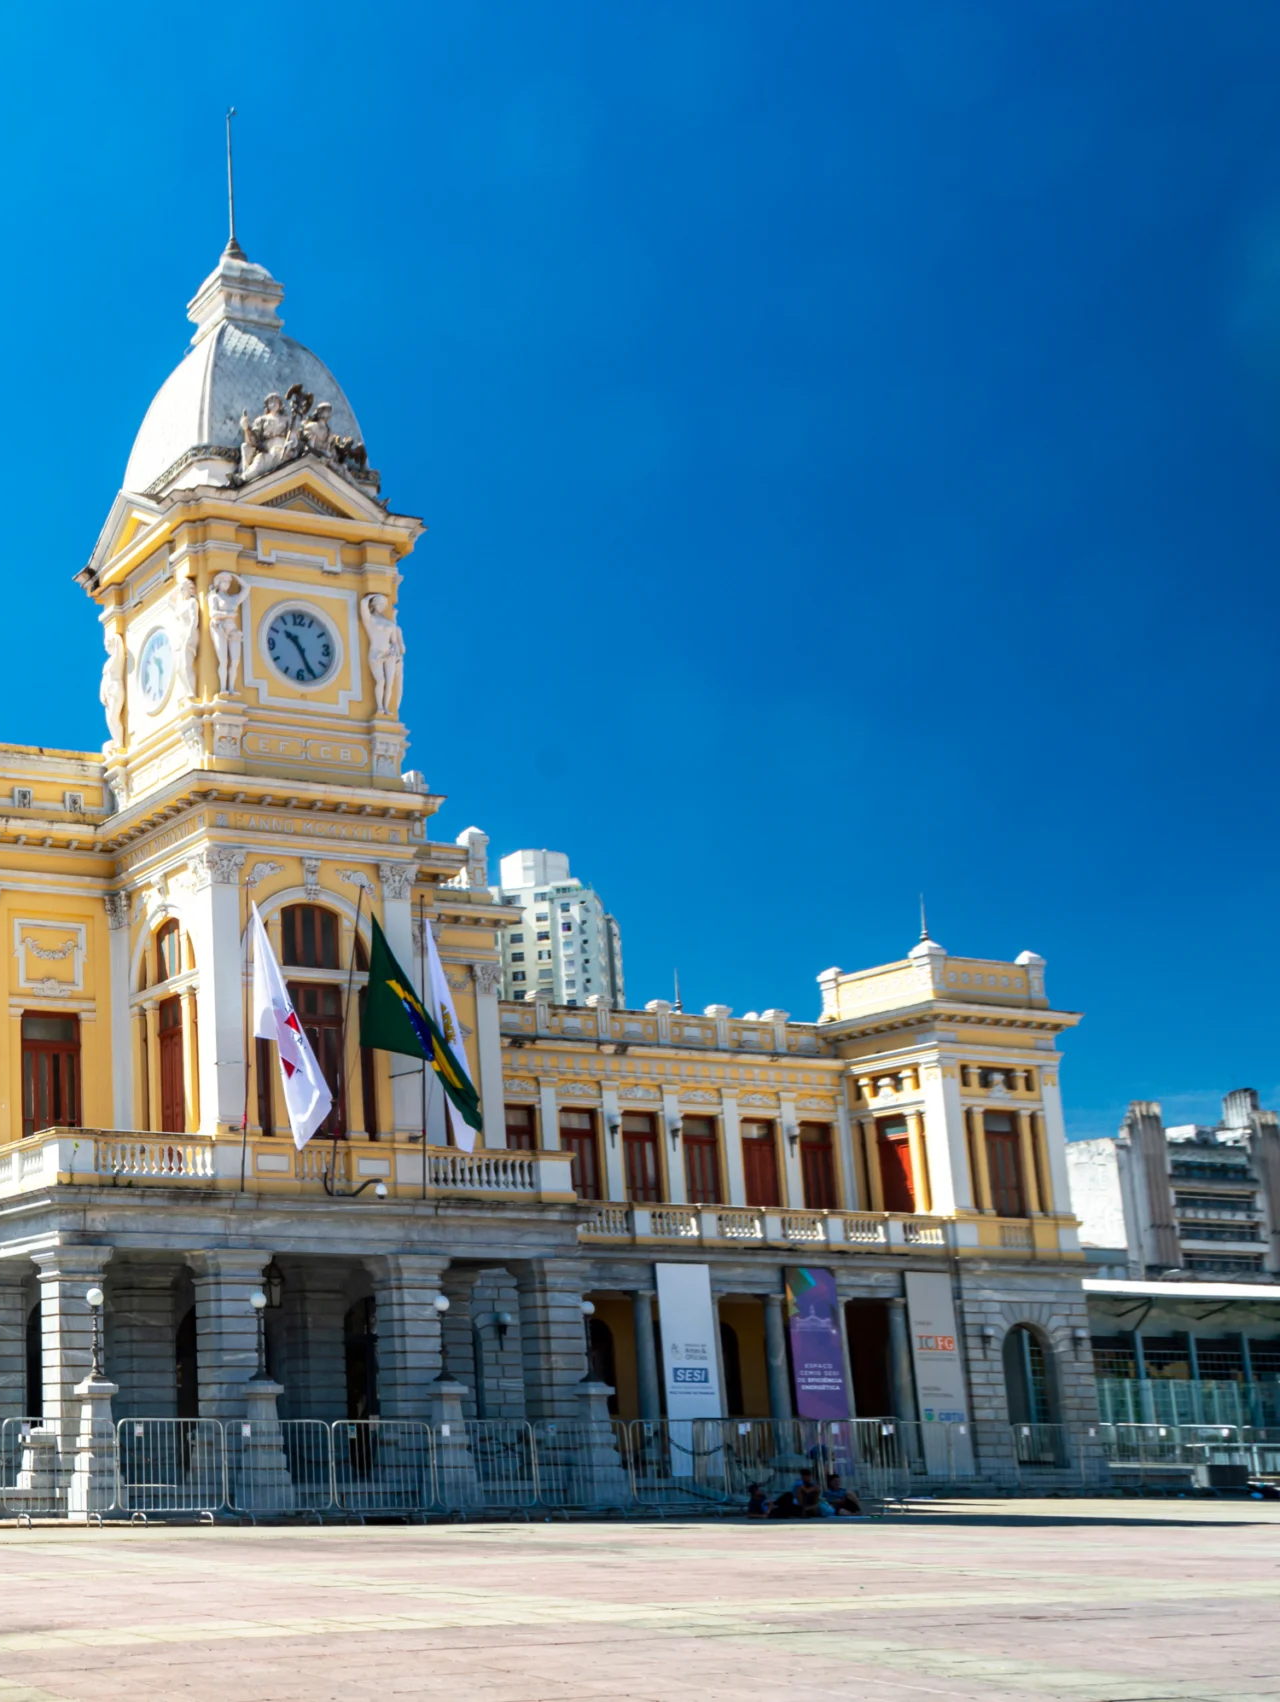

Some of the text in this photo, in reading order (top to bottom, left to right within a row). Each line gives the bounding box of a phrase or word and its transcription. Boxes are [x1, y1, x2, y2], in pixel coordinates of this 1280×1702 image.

[291, 612, 306, 627] 12
[267, 637, 276, 651] 9
[322, 644, 331, 657] 3
[296, 669, 305, 681] 6
[248, 815, 372, 841] ANNO MCMXXII
[676, 1369, 706, 1382] SESI
